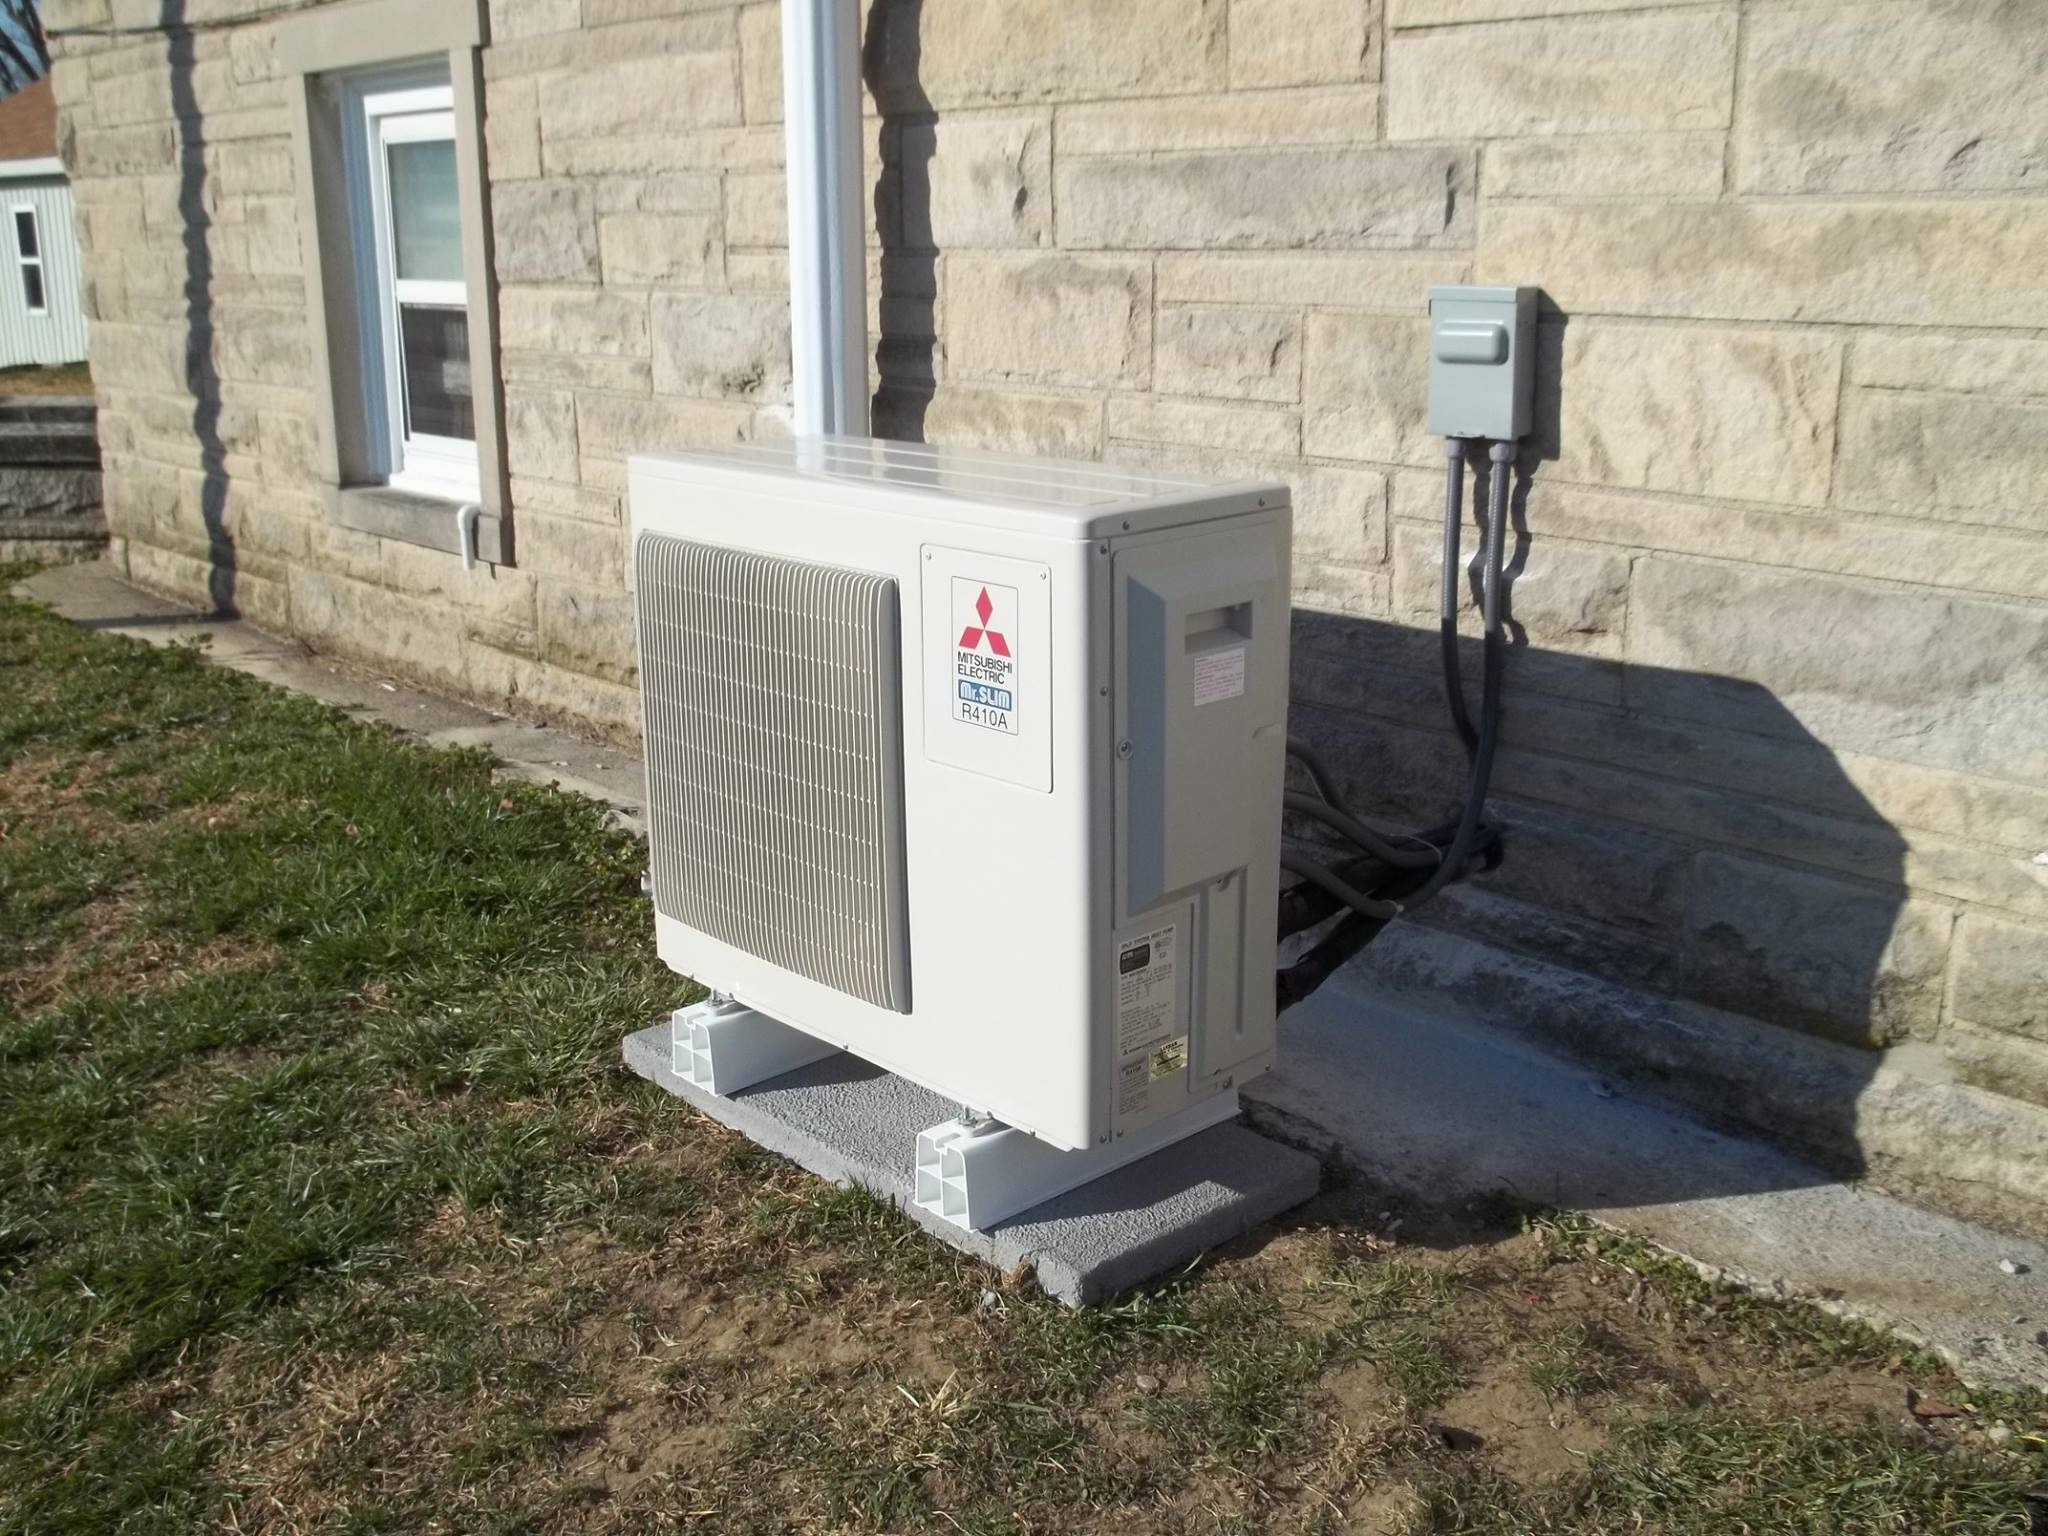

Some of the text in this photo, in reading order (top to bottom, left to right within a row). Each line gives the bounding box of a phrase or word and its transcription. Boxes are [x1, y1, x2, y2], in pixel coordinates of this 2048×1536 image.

[958, 651, 1012, 674] MITSUBISHI
[958, 663, 1005, 684] ELECTRIC
[962, 702, 1008, 729] R410A
